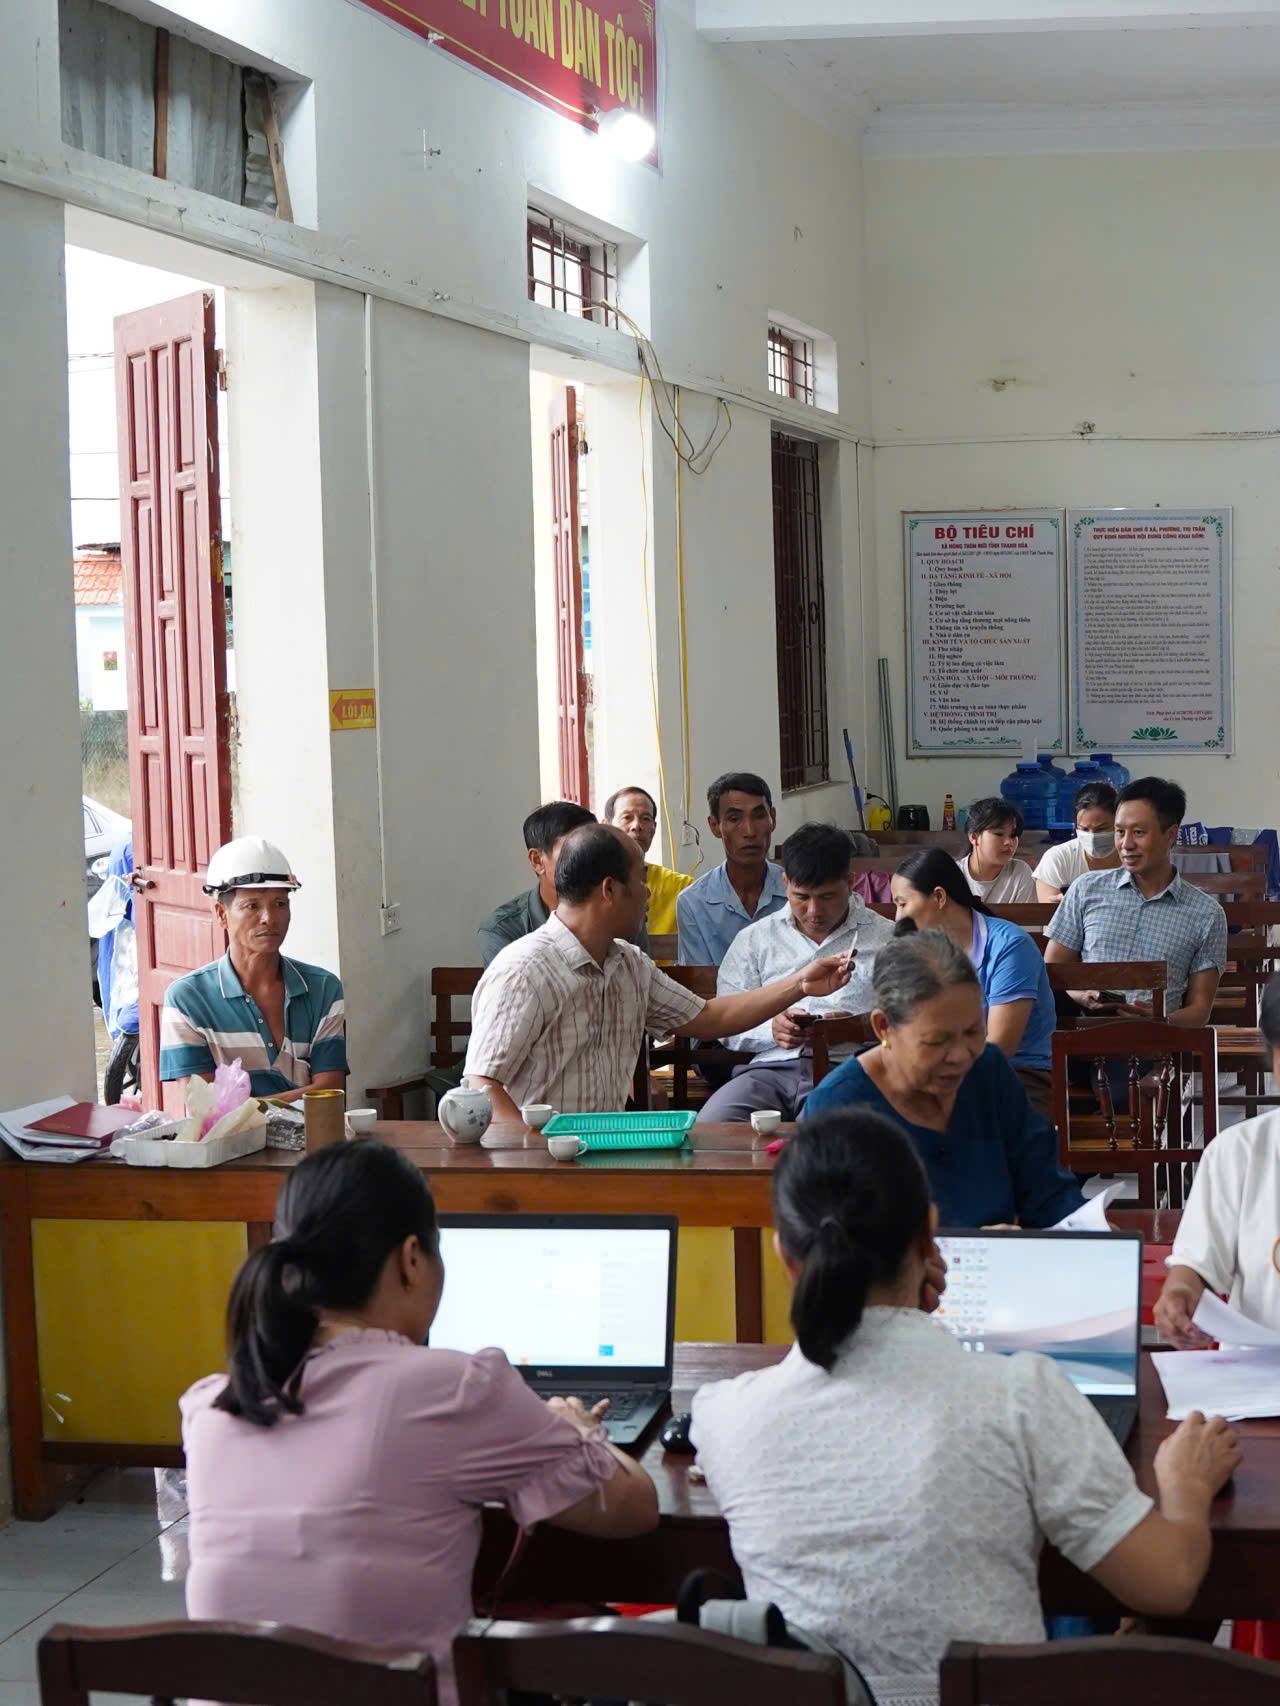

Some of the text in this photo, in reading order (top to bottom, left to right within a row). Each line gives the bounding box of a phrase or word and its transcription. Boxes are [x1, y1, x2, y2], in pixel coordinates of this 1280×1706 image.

[935, 524, 1034, 541] BỘ TIÊU CHÍ
